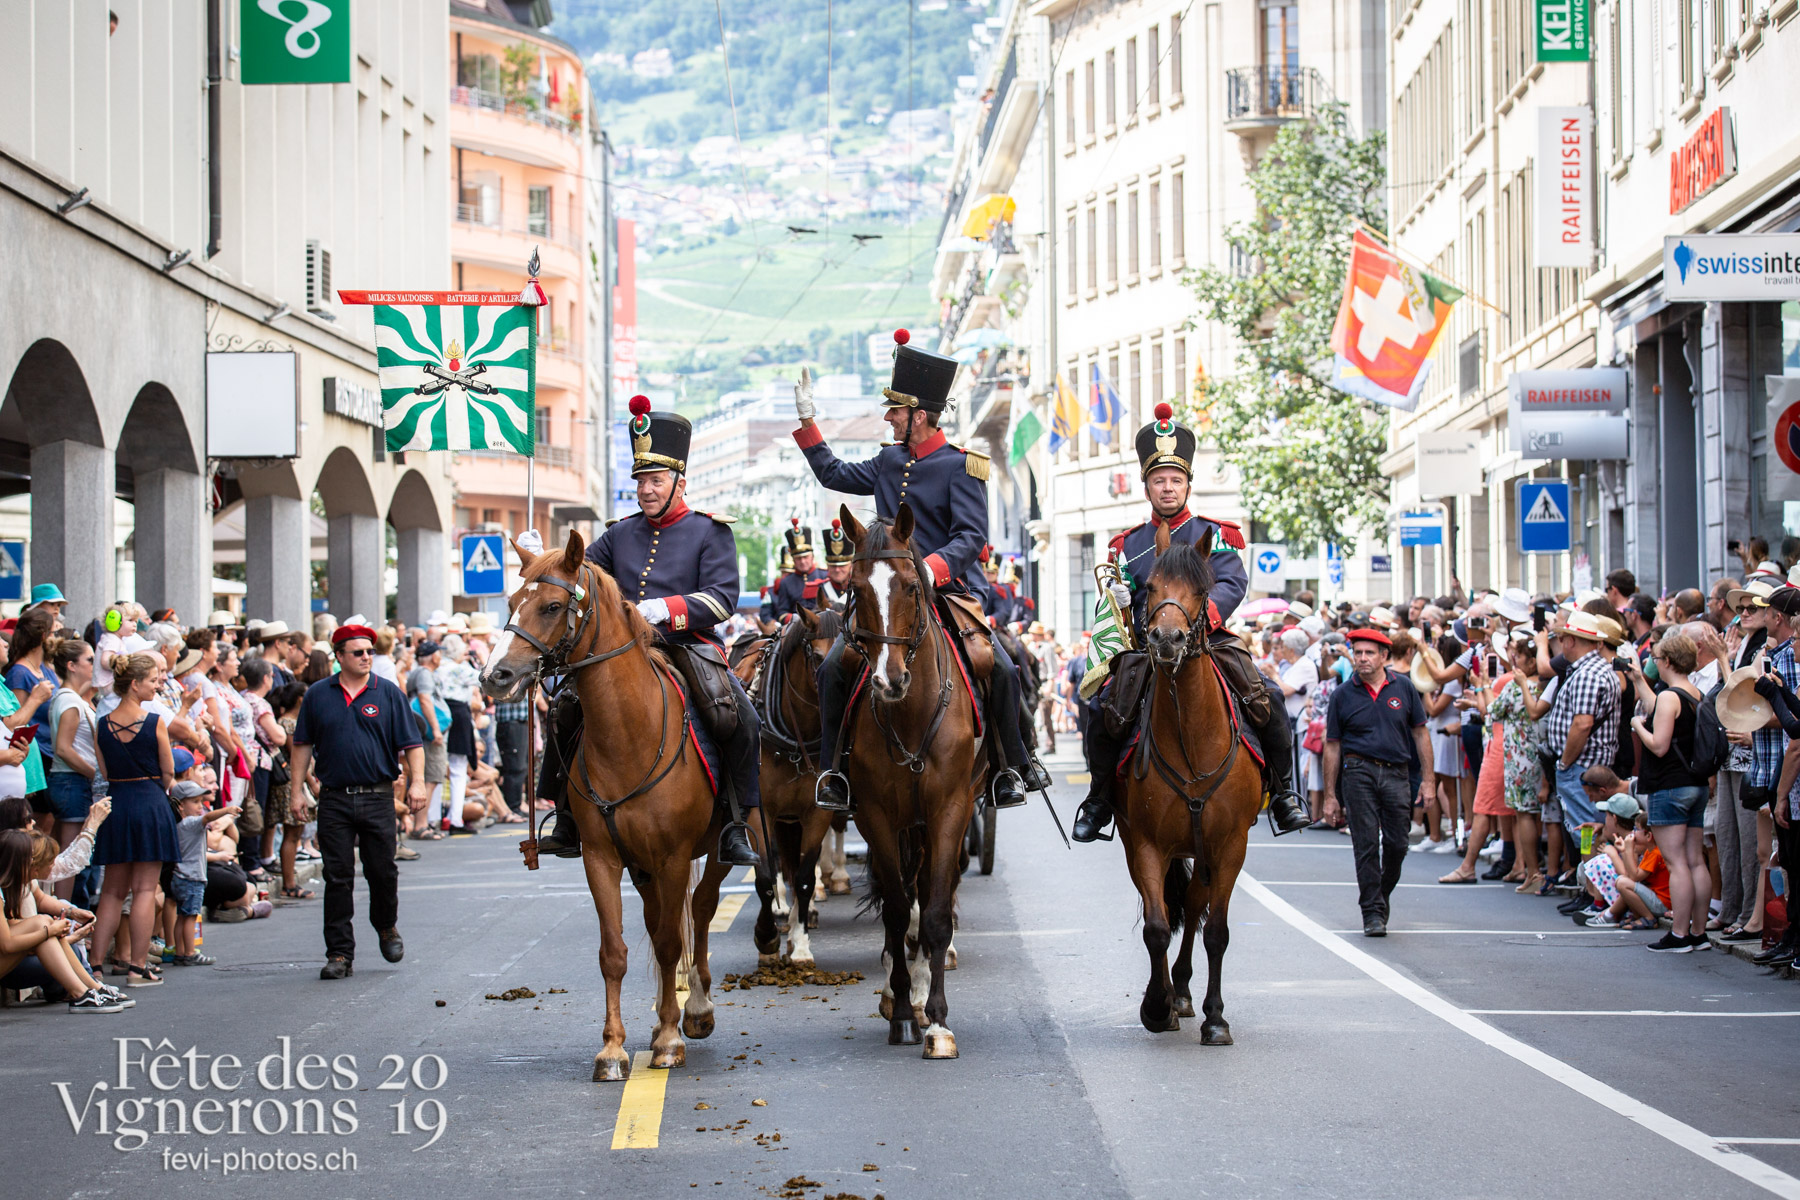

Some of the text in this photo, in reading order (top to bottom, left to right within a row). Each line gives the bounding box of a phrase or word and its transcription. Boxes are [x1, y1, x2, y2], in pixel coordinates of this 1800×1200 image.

[1669, 106, 1725, 215] RAIFFEISEN
[1562, 118, 1581, 244] RAIFFEISEN
[1764, 275, 1794, 286] travail
[367, 293, 434, 303] MILICES VAUDOISES
[446, 294, 480, 303] BATTERIE
[1528, 388, 1612, 404] RAIFFEISEN
